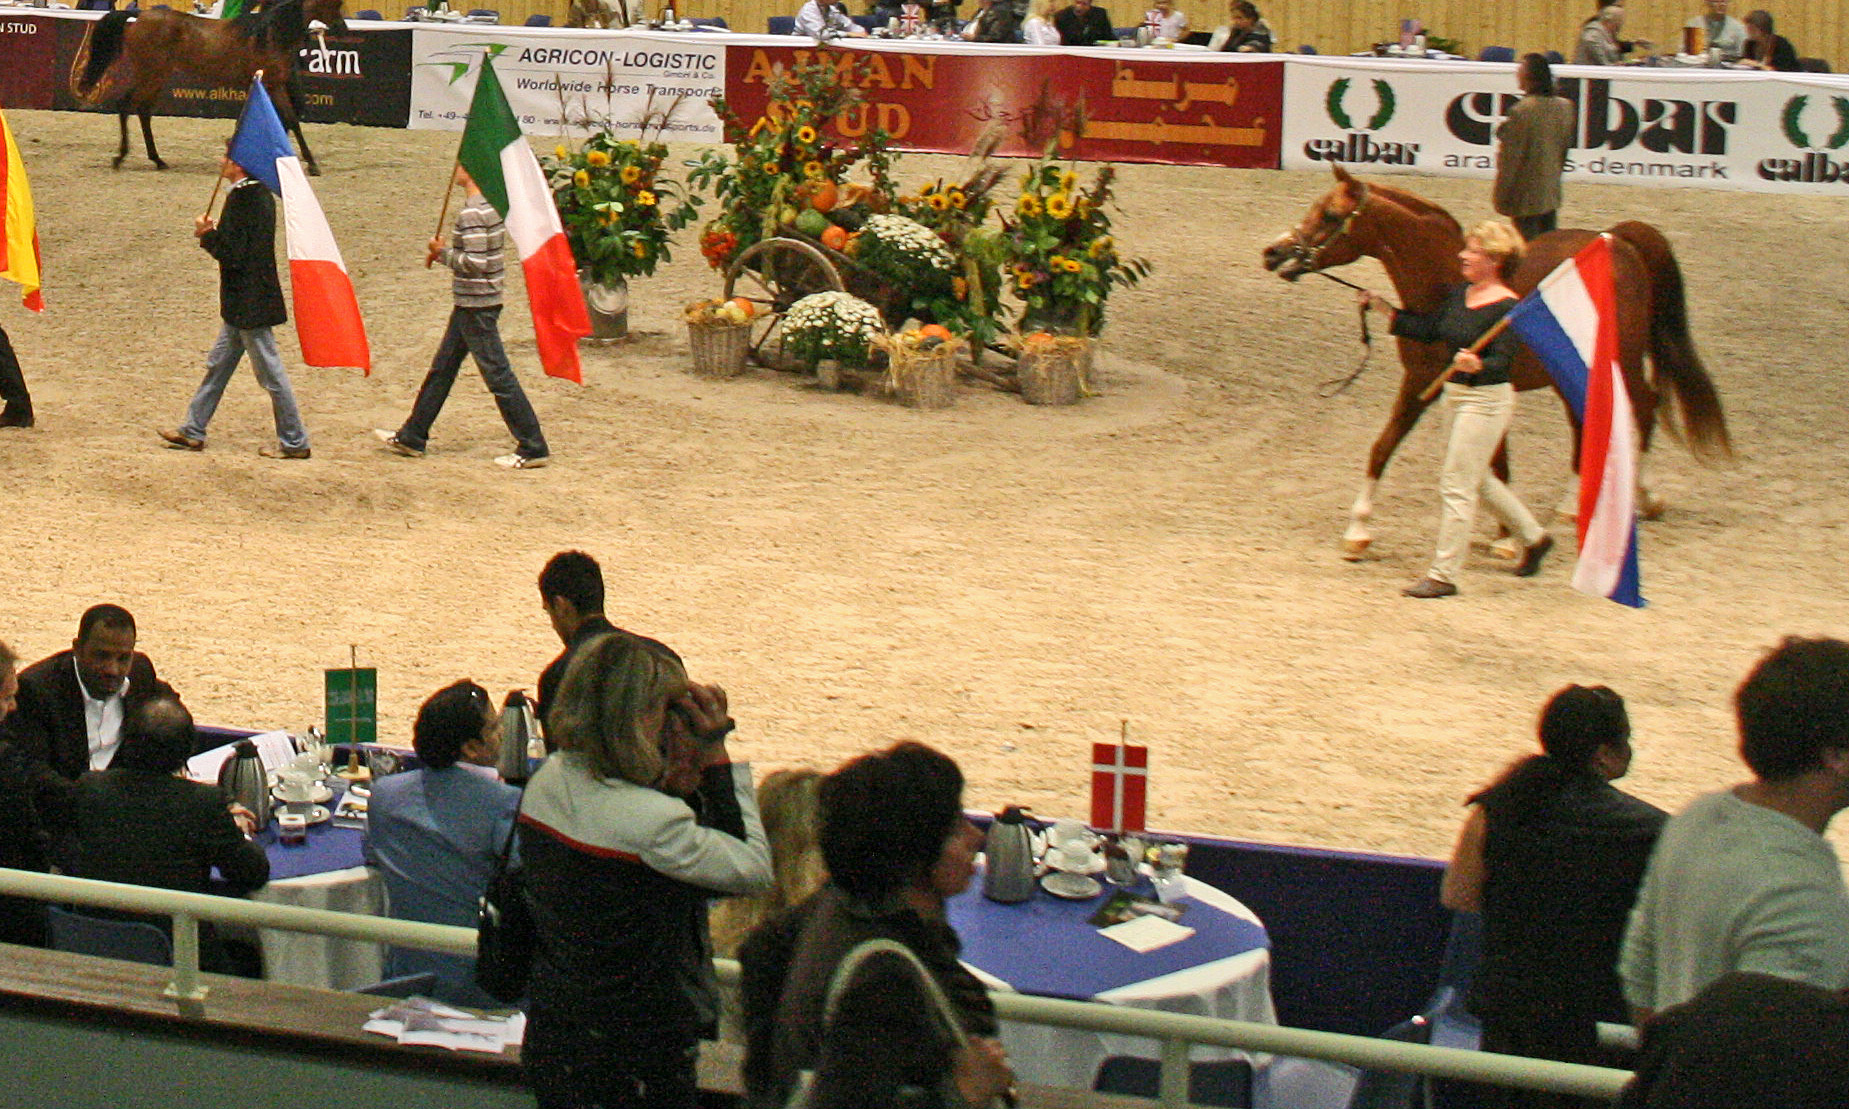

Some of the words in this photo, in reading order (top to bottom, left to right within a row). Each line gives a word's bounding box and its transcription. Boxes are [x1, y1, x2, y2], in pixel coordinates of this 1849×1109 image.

[7, 22, 37, 34] STUD
[299, 47, 361, 76] arm
[518, 47, 717, 70] AGRICON-LOGISTIC
[516, 77, 593, 93] Worldwide
[596, 81, 640, 95] Horse
[765, 99, 912, 140] SUD
[1444, 77, 1737, 155] clbar
[1303, 133, 1421, 166] calbar
[1443, 154, 1729, 180] aras-denmark
